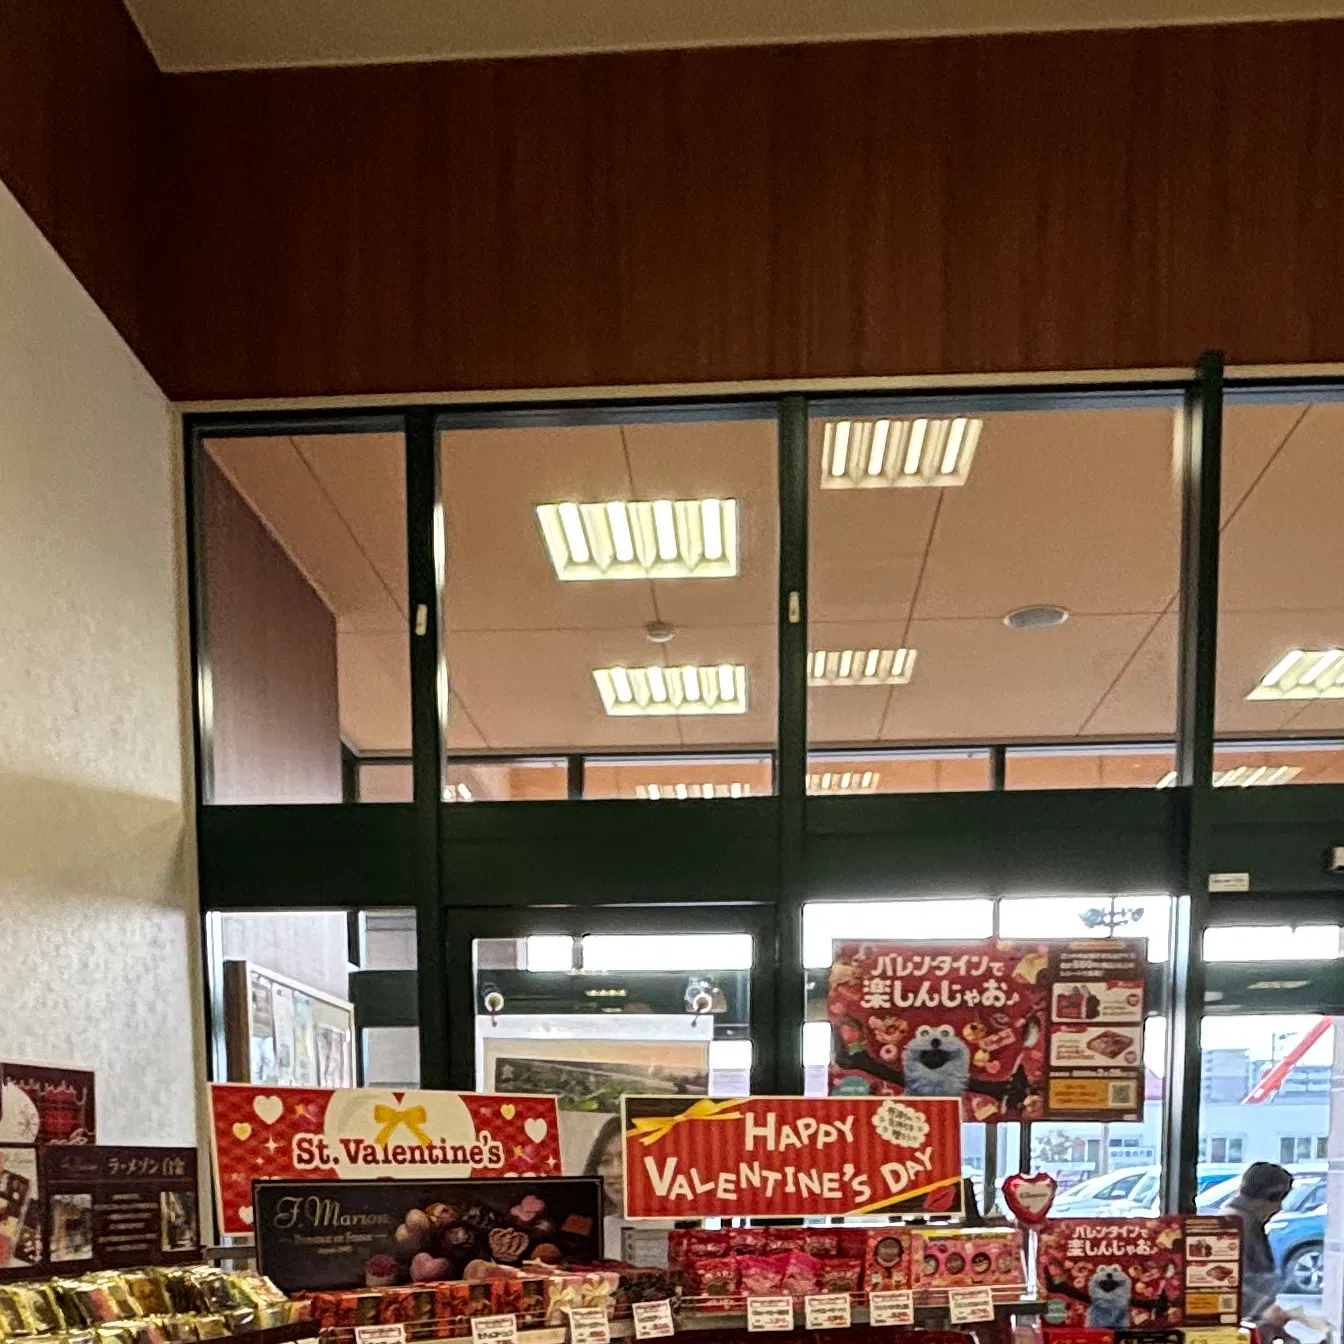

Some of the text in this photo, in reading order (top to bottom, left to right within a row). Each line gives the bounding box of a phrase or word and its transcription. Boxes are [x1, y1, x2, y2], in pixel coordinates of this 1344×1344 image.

[871, 952, 1005, 978] バレンタインで
[1072, 1225, 1149, 1239] バレンタインで
